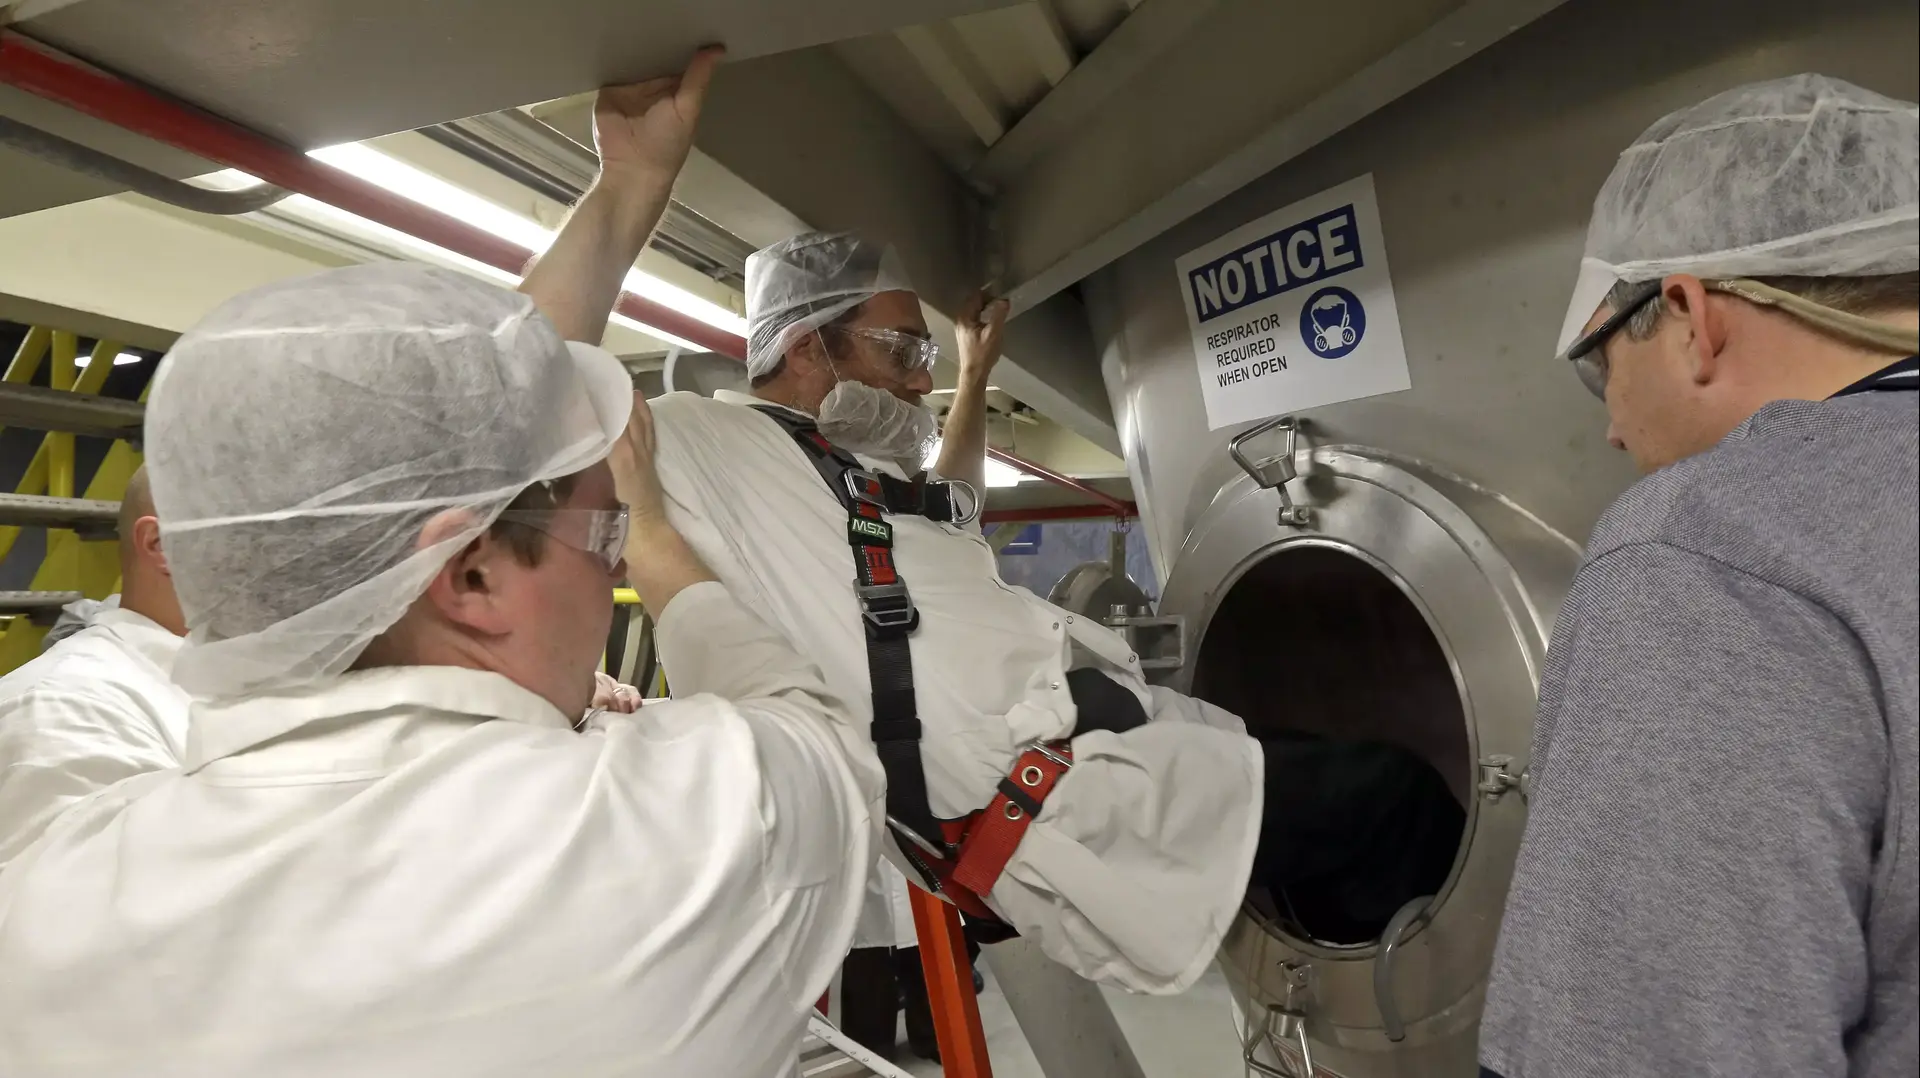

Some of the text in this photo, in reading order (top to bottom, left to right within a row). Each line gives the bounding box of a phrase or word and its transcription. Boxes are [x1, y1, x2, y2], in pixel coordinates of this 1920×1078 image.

[1194, 214, 1355, 315] NOTICE
[1207, 313, 1280, 350] RESPIRATOR
[1216, 337, 1276, 368] REQUIRED
[1217, 355, 1288, 388] WHEN OPEN
[852, 518, 888, 539] MSA
